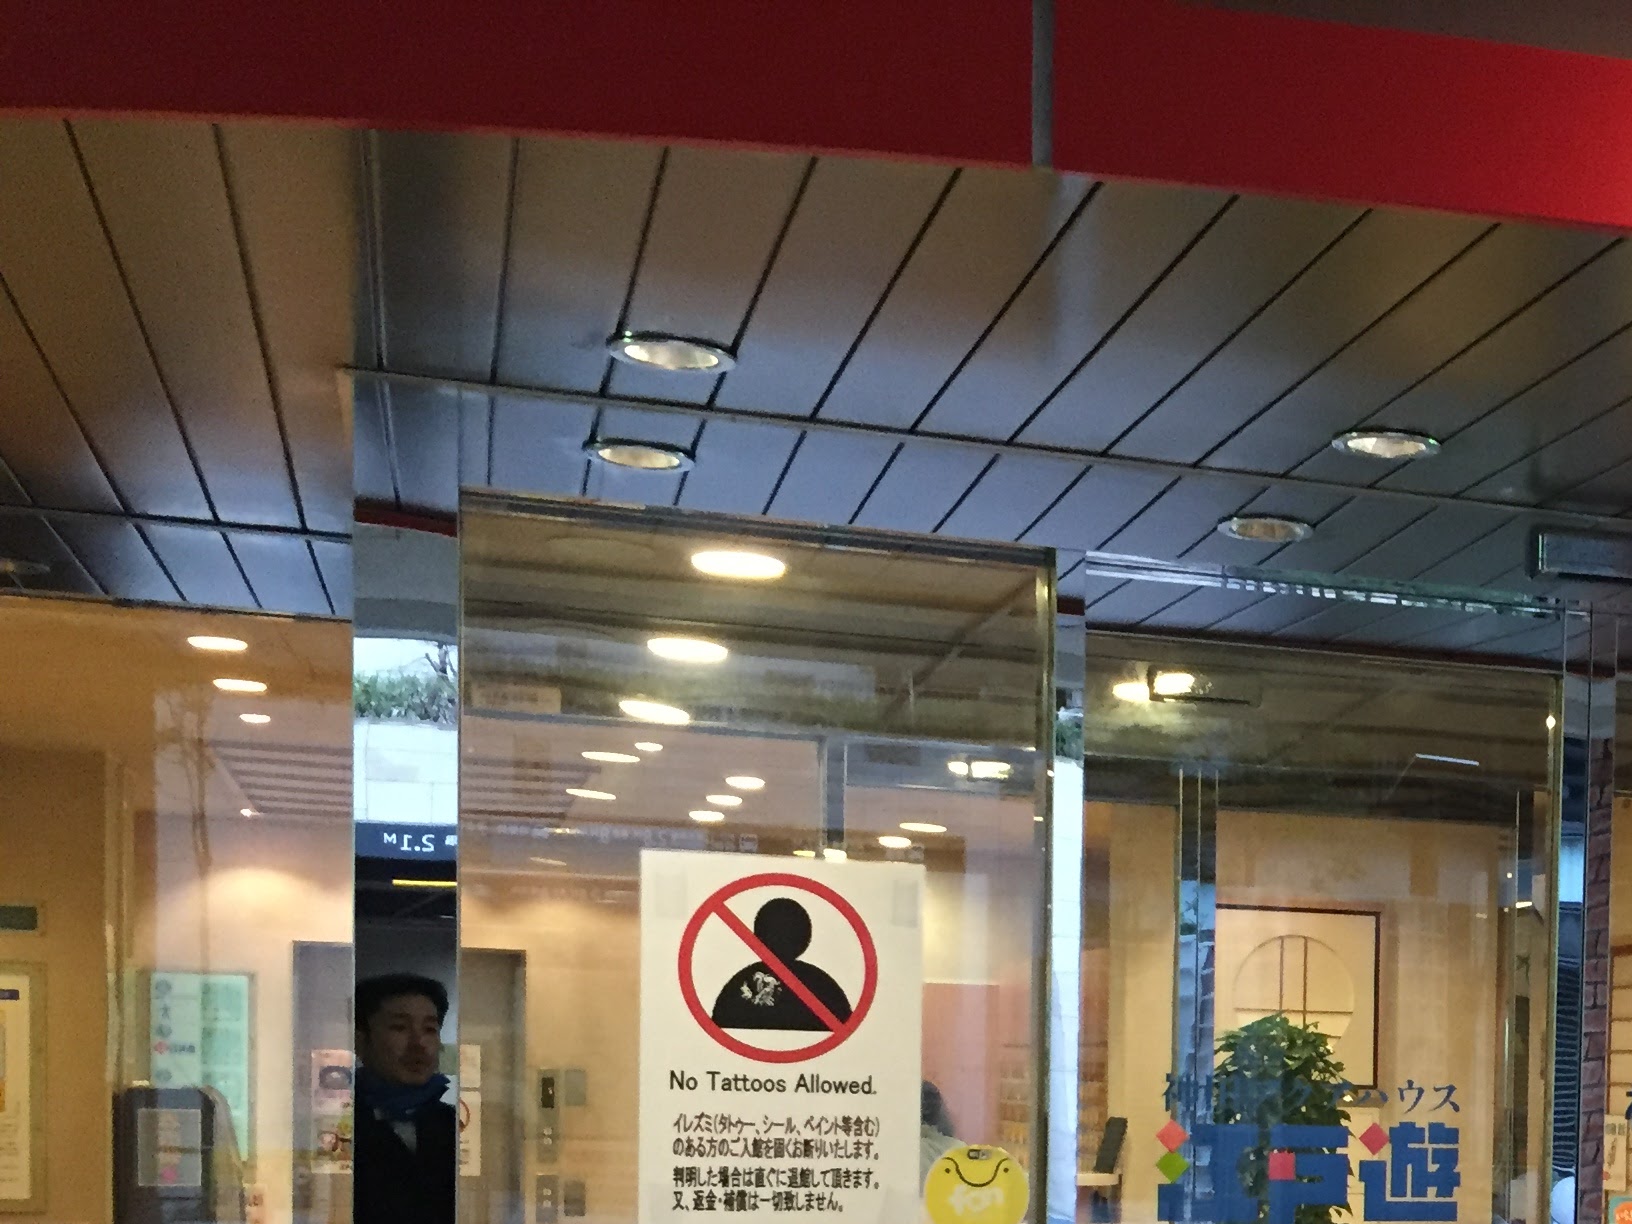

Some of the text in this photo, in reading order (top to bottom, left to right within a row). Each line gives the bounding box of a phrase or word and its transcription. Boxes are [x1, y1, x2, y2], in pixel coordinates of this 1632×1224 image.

[669, 1070, 878, 1095] No Tattoos Allowed.
